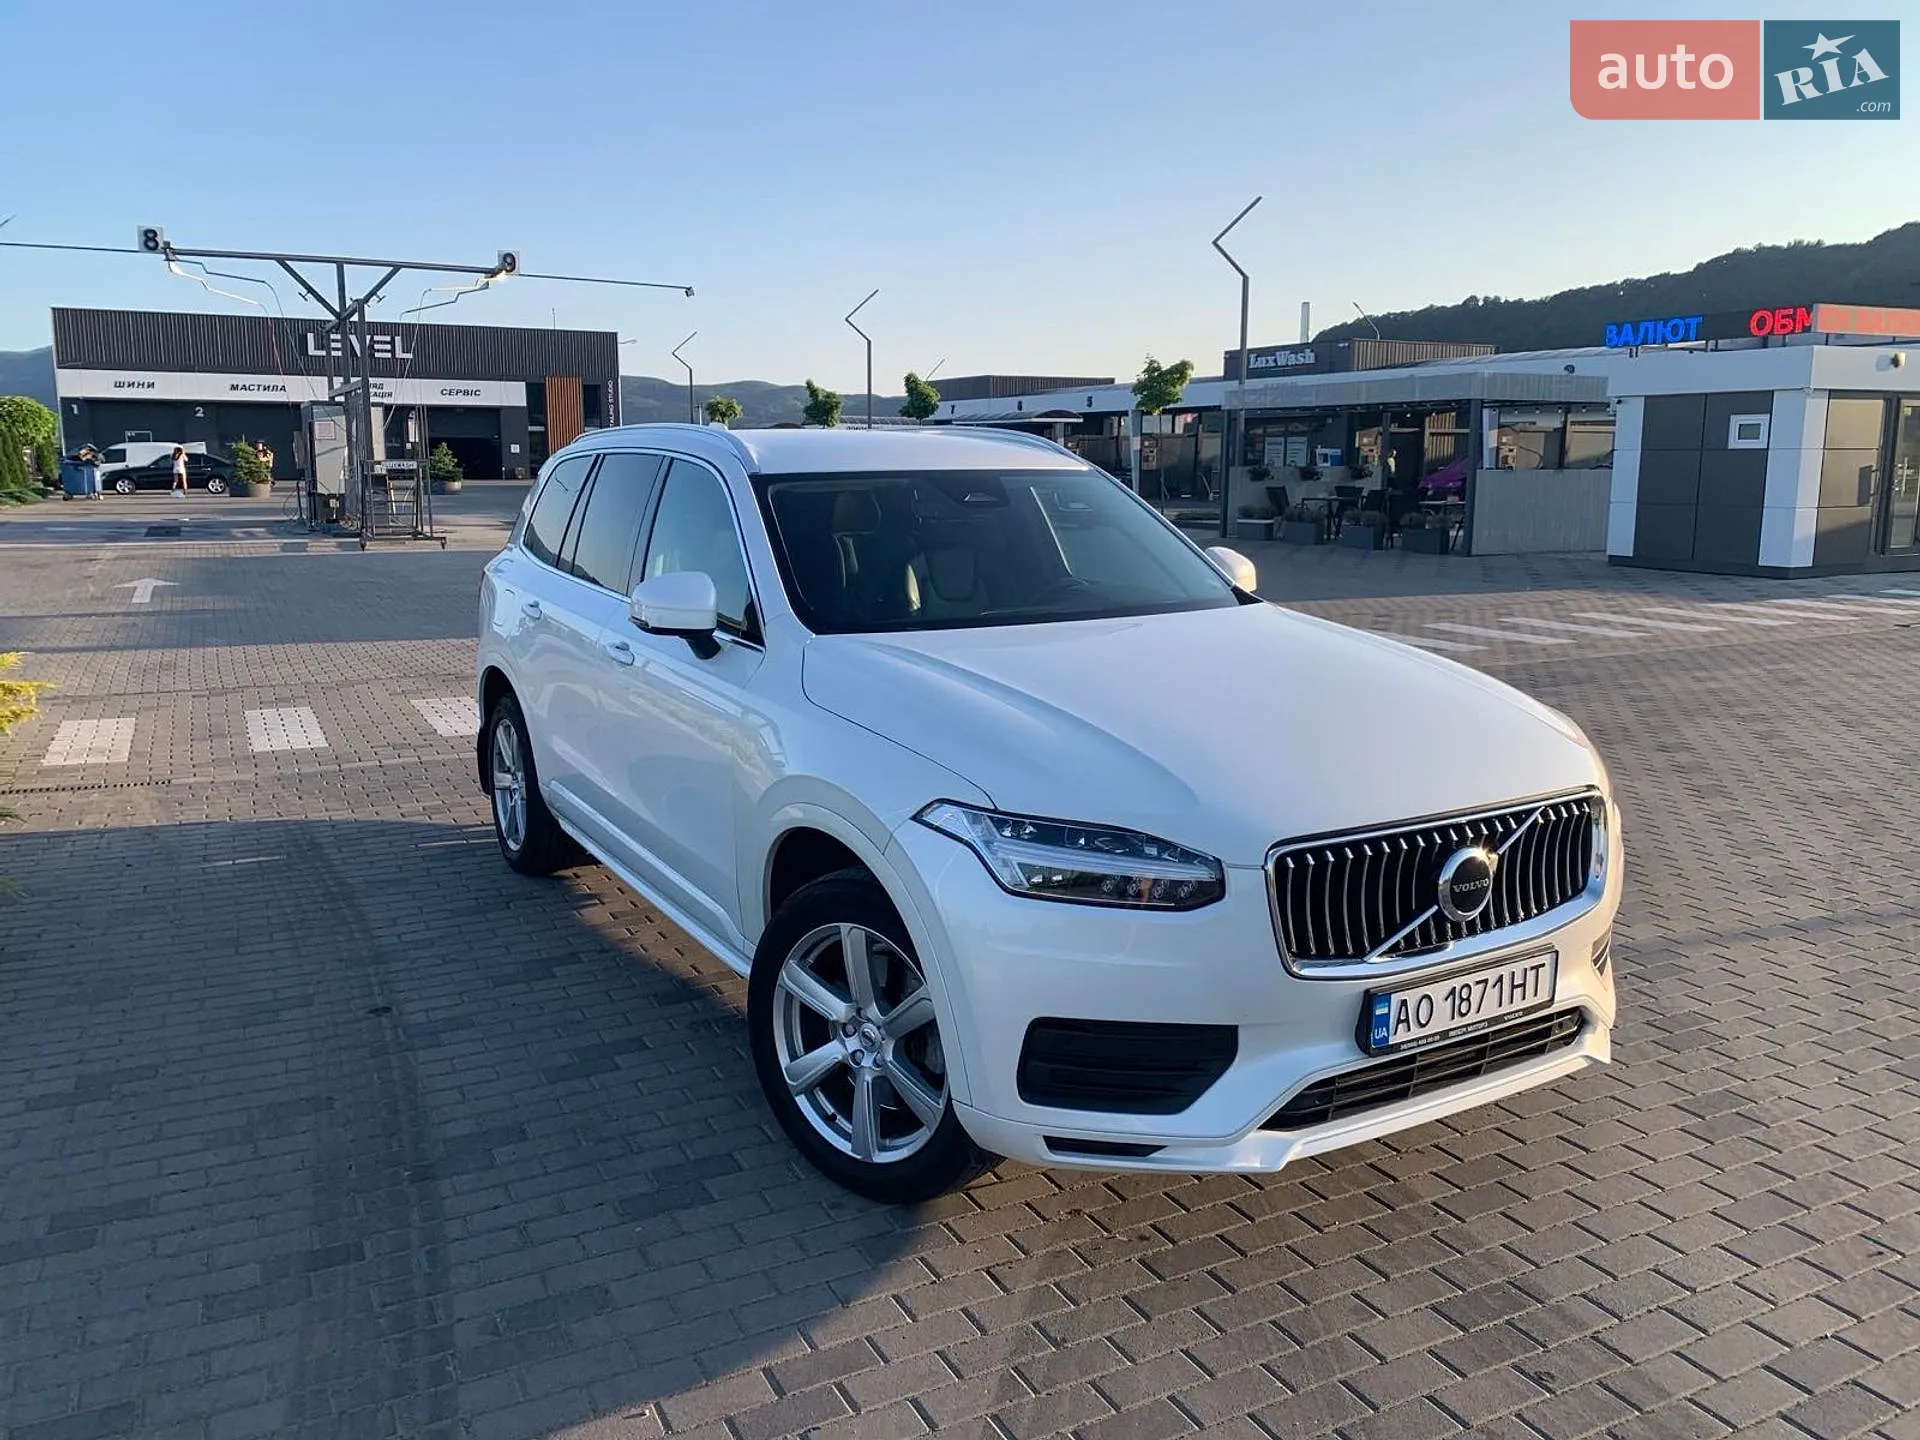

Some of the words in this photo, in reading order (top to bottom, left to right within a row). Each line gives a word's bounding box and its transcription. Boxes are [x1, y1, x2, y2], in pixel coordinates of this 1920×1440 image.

[143, 228, 159, 250] 8
[503, 252, 516, 273] 9
[1605, 315, 1704, 347] ВАЛЮТ
[307, 332, 413, 359] LEVEL
[1248, 348, 1316, 369] LuxWash
[113, 380, 155, 390] ШИНИ
[229, 383, 287, 393] МАСТИЛА
[440, 388, 482, 398] СЕРВІС
[70, 404, 79, 415] 1
[194, 406, 205, 417] 2
[1452, 878, 1490, 893] VOLVO
[1393, 993, 1434, 1036] AO
[1374, 1027, 1388, 1040] UA
